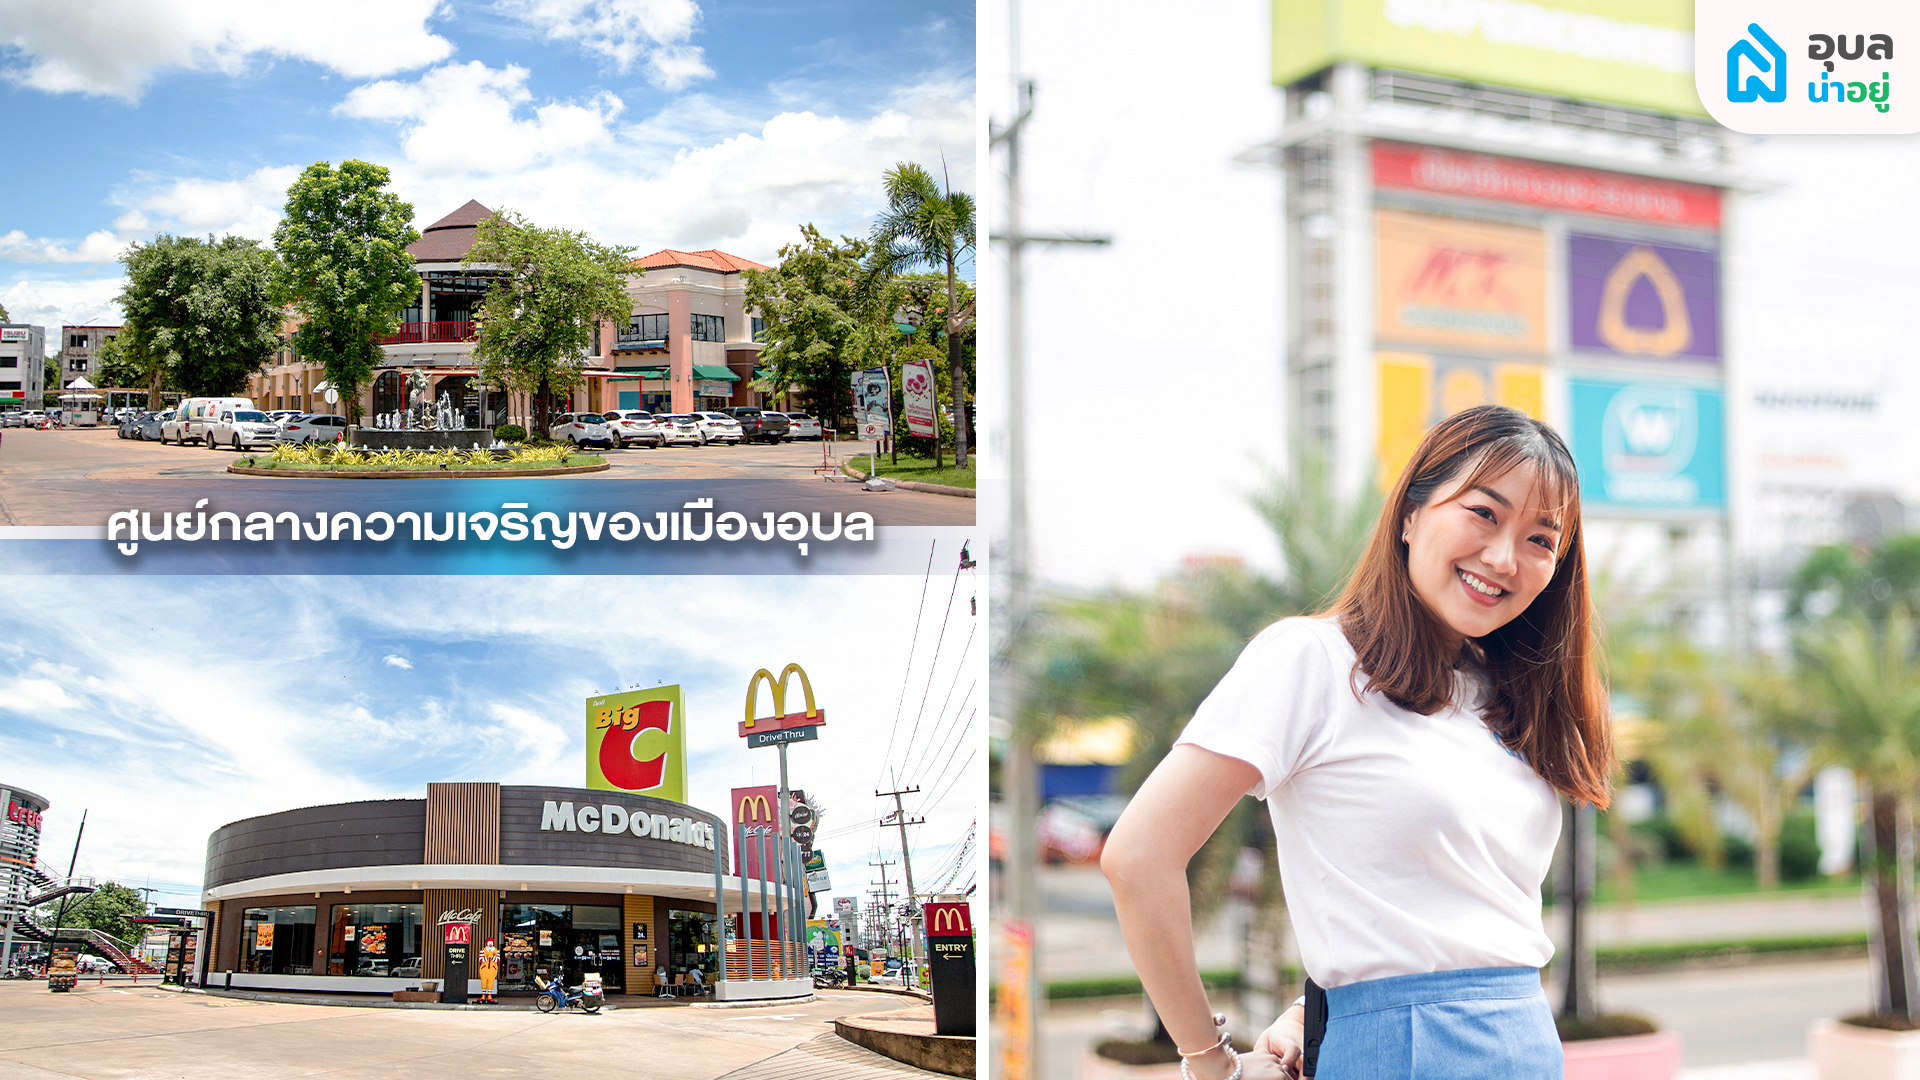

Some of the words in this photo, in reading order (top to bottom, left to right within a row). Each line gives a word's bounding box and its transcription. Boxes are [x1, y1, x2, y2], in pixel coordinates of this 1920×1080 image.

[595, 704, 641, 731] Big
[598, 700, 674, 792] C
[759, 733, 783, 743] Drive
[783, 730, 805, 739] Thru
[8, 800, 43, 829] true
[540, 800, 715, 850] McDonald's
[934, 943, 968, 952] ENTRY
